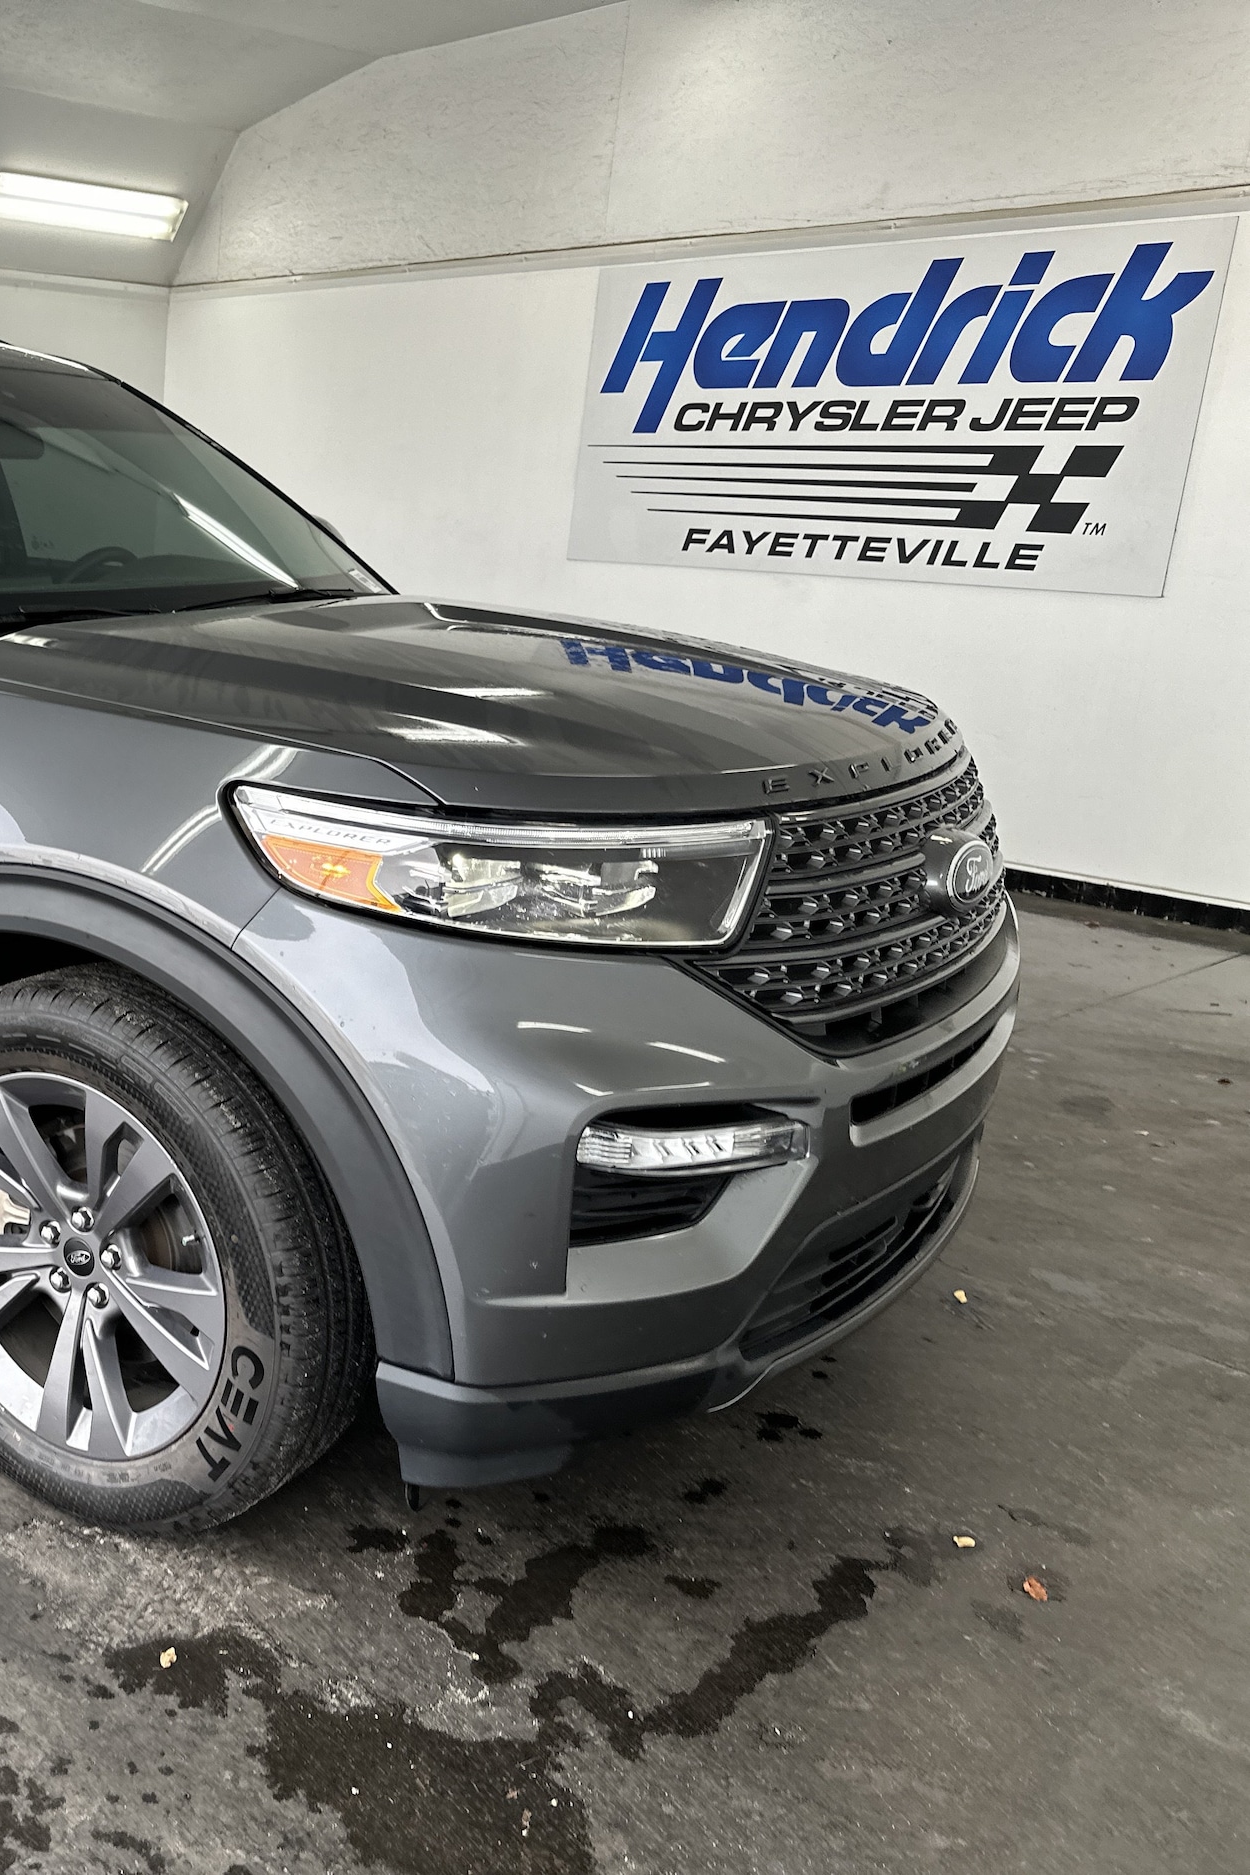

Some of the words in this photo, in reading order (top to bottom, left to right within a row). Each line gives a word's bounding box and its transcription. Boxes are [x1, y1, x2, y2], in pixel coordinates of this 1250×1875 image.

[600, 241, 1215, 434] Hendrick
[673, 397, 967, 432] CHRYSLER
[969, 395, 1140, 432] JEEP
[681, 527, 1045, 572] FAYETTEVILLE
[1082, 522, 1107, 536] TM
[270, 818, 392, 845] EXPLORER
[196, 1345, 265, 1483] CEAT
